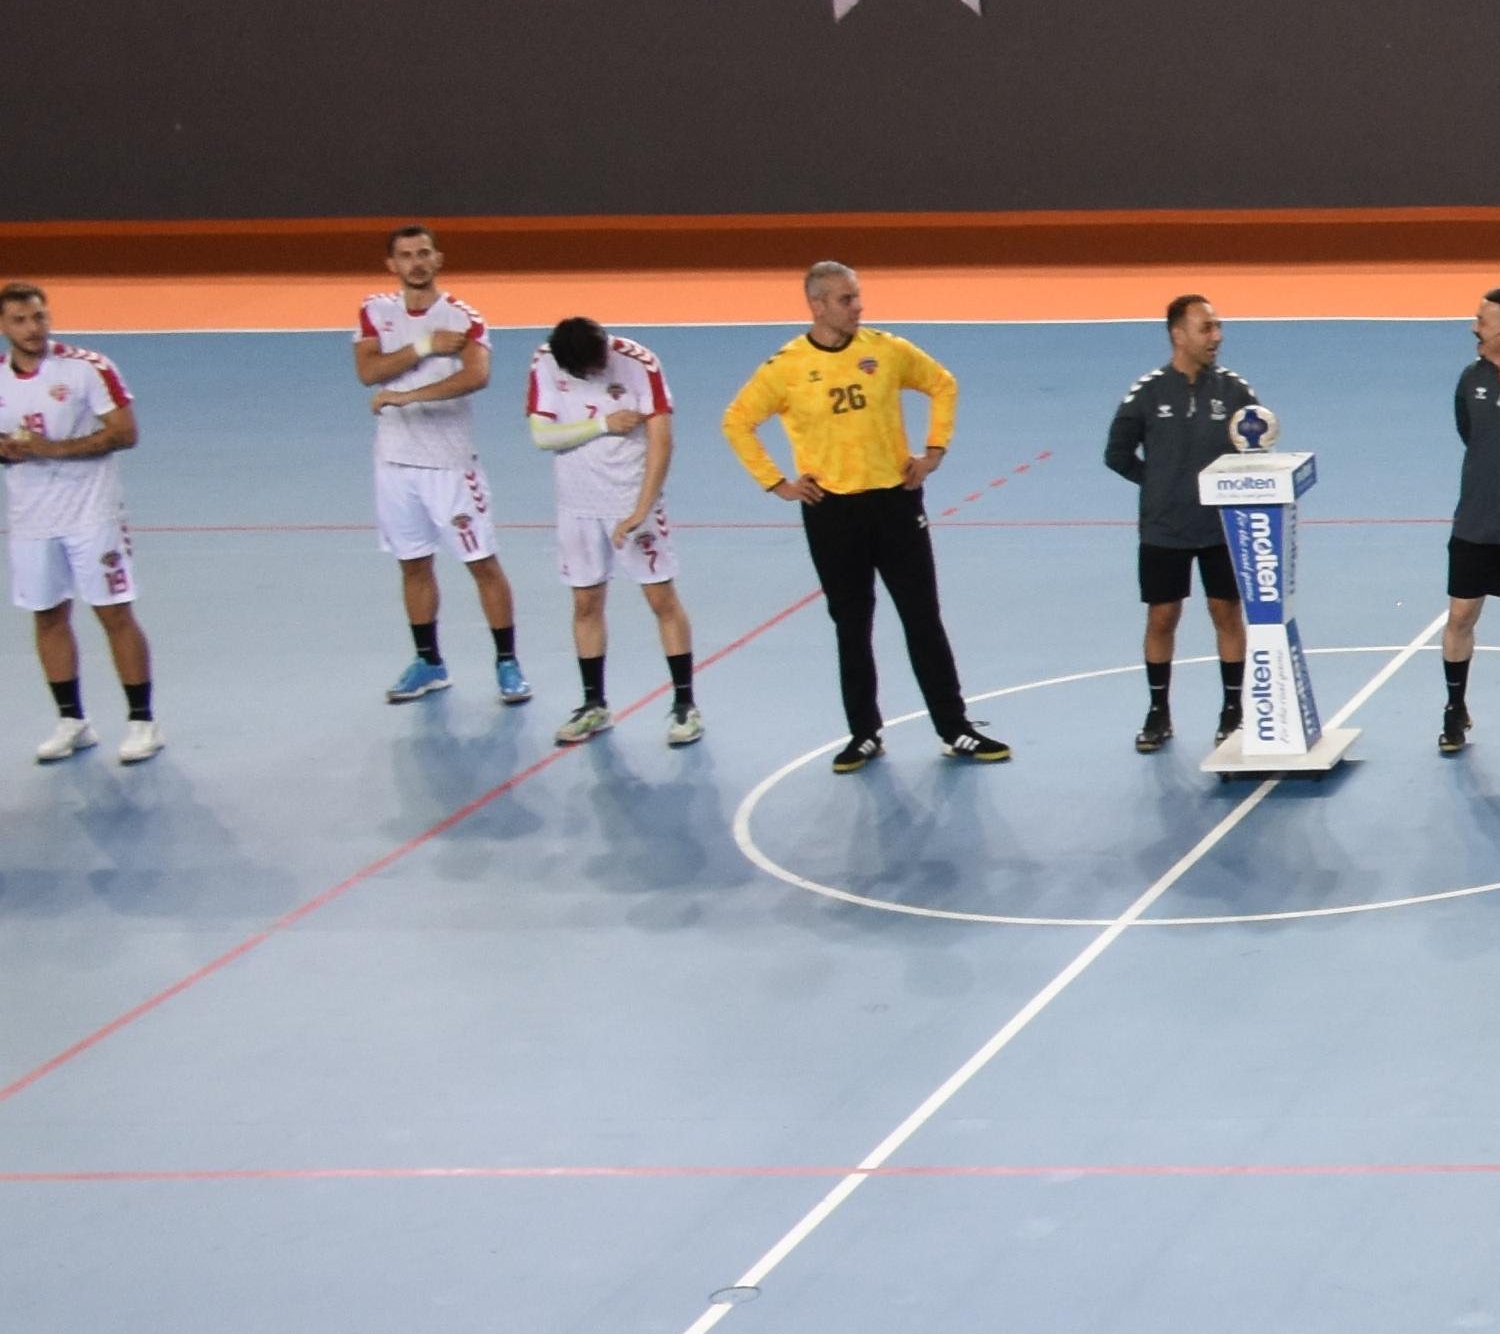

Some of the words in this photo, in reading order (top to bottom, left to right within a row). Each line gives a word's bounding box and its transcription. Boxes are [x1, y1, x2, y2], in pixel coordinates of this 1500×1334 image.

[828, 383, 867, 415] 26
[1217, 476, 1276, 491] molten
[458, 528, 480, 554] 11
[644, 550, 658, 575] 7
[1249, 511, 1280, 602] molten
[1252, 650, 1275, 742] molten
